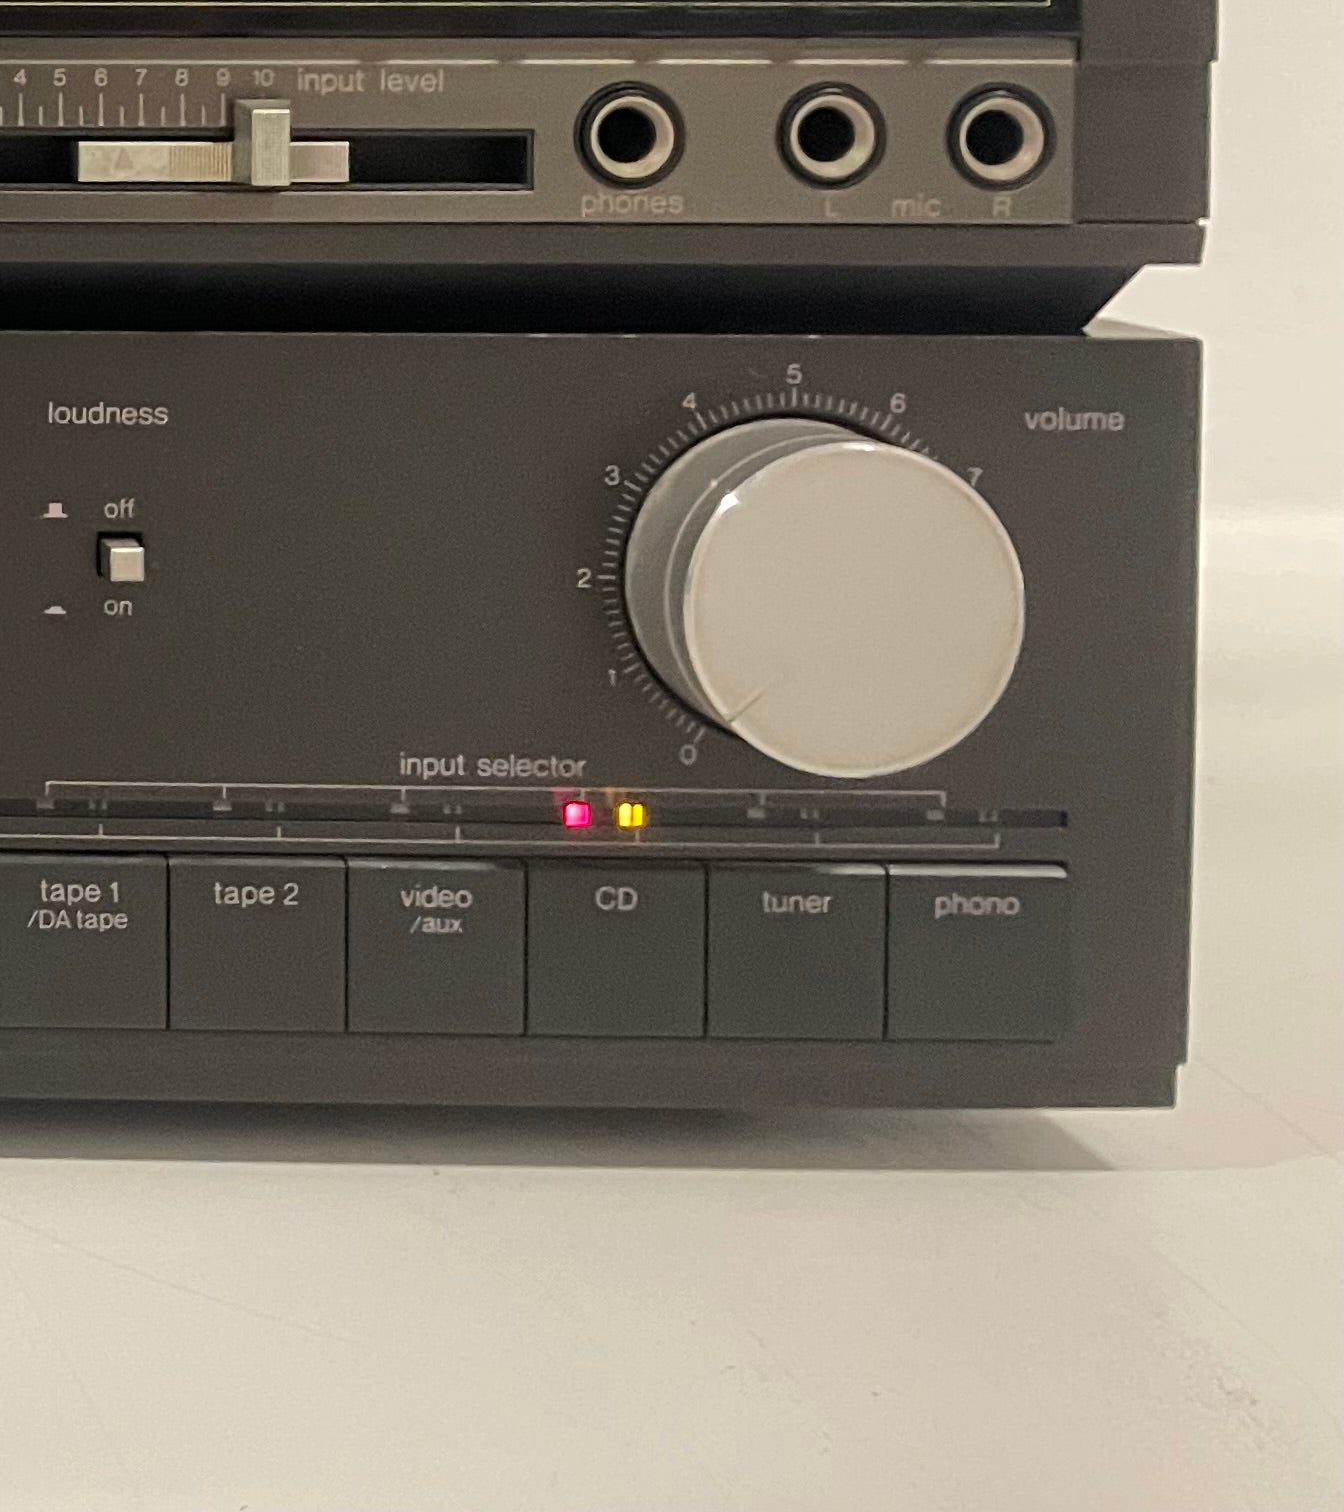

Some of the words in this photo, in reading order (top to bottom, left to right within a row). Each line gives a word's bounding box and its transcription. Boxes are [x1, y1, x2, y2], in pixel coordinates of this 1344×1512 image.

[252, 68, 274, 86] 10
[297, 68, 365, 96] input
[381, 68, 444, 93] level
[580, 190, 684, 218] phones
[47, 401, 168, 426] loudness
[1024, 407, 1126, 432] volume
[399, 752, 466, 780] input
[476, 754, 586, 778] selector
[40, 879, 100, 907] tape
[109, 881, 120, 902] 1
[214, 882, 276, 908] tape
[282, 882, 299, 905] 2
[400, 884, 472, 909] video
[594, 886, 638, 910] CD
[762, 891, 832, 914] tuner
[934, 892, 1020, 919] phono
[27, 908, 72, 930] /DA
[76, 909, 128, 932] tape
[410, 915, 462, 934] /aux
